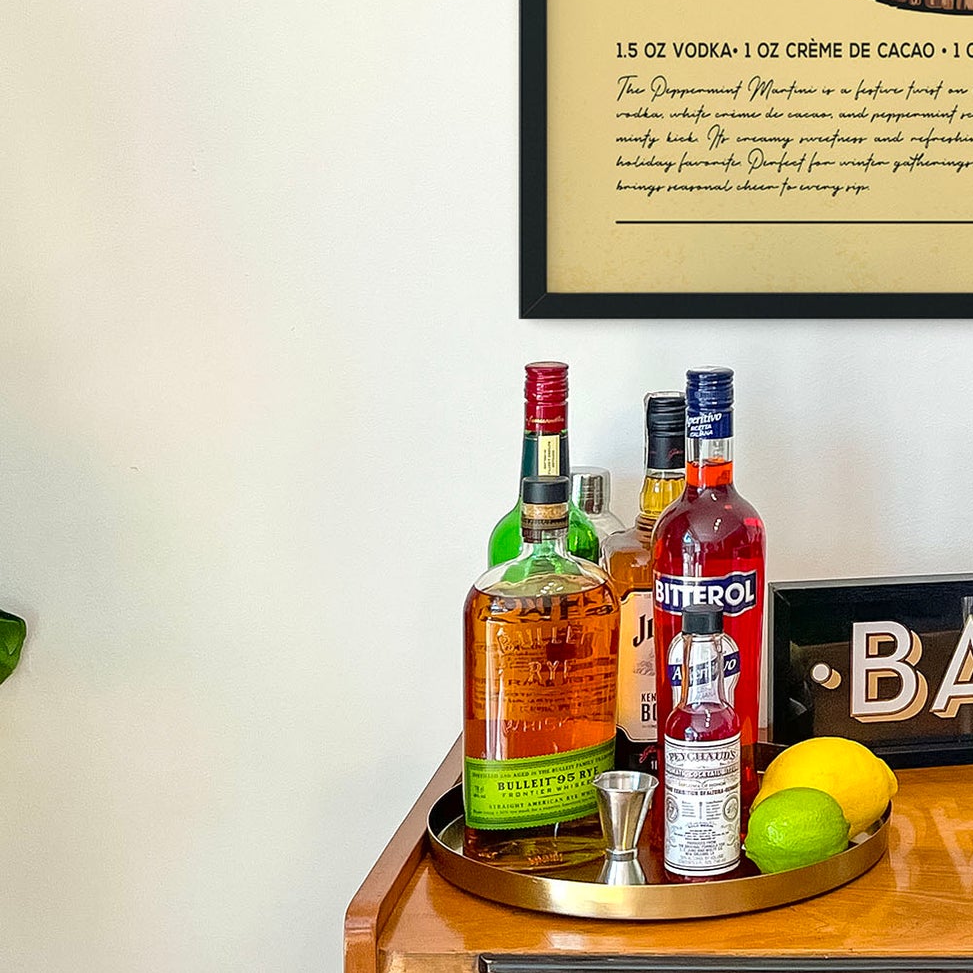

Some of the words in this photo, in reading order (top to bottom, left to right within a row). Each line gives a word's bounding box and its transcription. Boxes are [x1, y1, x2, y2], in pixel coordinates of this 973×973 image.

[616, 42, 638, 58] 1.5
[644, 42, 666, 59] OZ
[744, 42, 751, 58] 1
[757, 42, 780, 59] OZ
[785, 37, 843, 59] CRÈME
[849, 42, 871, 58] DE
[877, 42, 935, 59] CACAO
[953, 42, 960, 58] 1
[617, 75, 646, 101] The
[650, 75, 743, 102] Peppermint
[747, 75, 817, 102] Martini
[822, 86, 835, 95] is
[855, 79, 904, 101] festive
[906, 79, 944, 100] twist
[669, 105, 712, 125] white
[765, 107, 784, 119] de
[838, 107, 869, 119] and
[870, 104, 958, 124] peppermint
[616, 129, 660, 149] minty
[736, 136, 794, 150] creamy
[799, 129, 868, 149] sweetness
[874, 132, 904, 143] and
[616, 152, 677, 174] holiday
[747, 148, 808, 175] Perfect
[808, 152, 836, 173] for
[839, 153, 890, 173] winter
[616, 179, 666, 197] brings
[666, 179, 733, 194] seasonal
[736, 179, 780, 191] cheer
[779, 177, 798, 196] to
[799, 184, 844, 197] every
[655, 579, 755, 607] BITTEROL
[497, 776, 553, 792] BULLEIT
[556, 772, 576, 785] 95
[579, 765, 600, 780] RYE
[502, 787, 553, 799] FRONTIER
